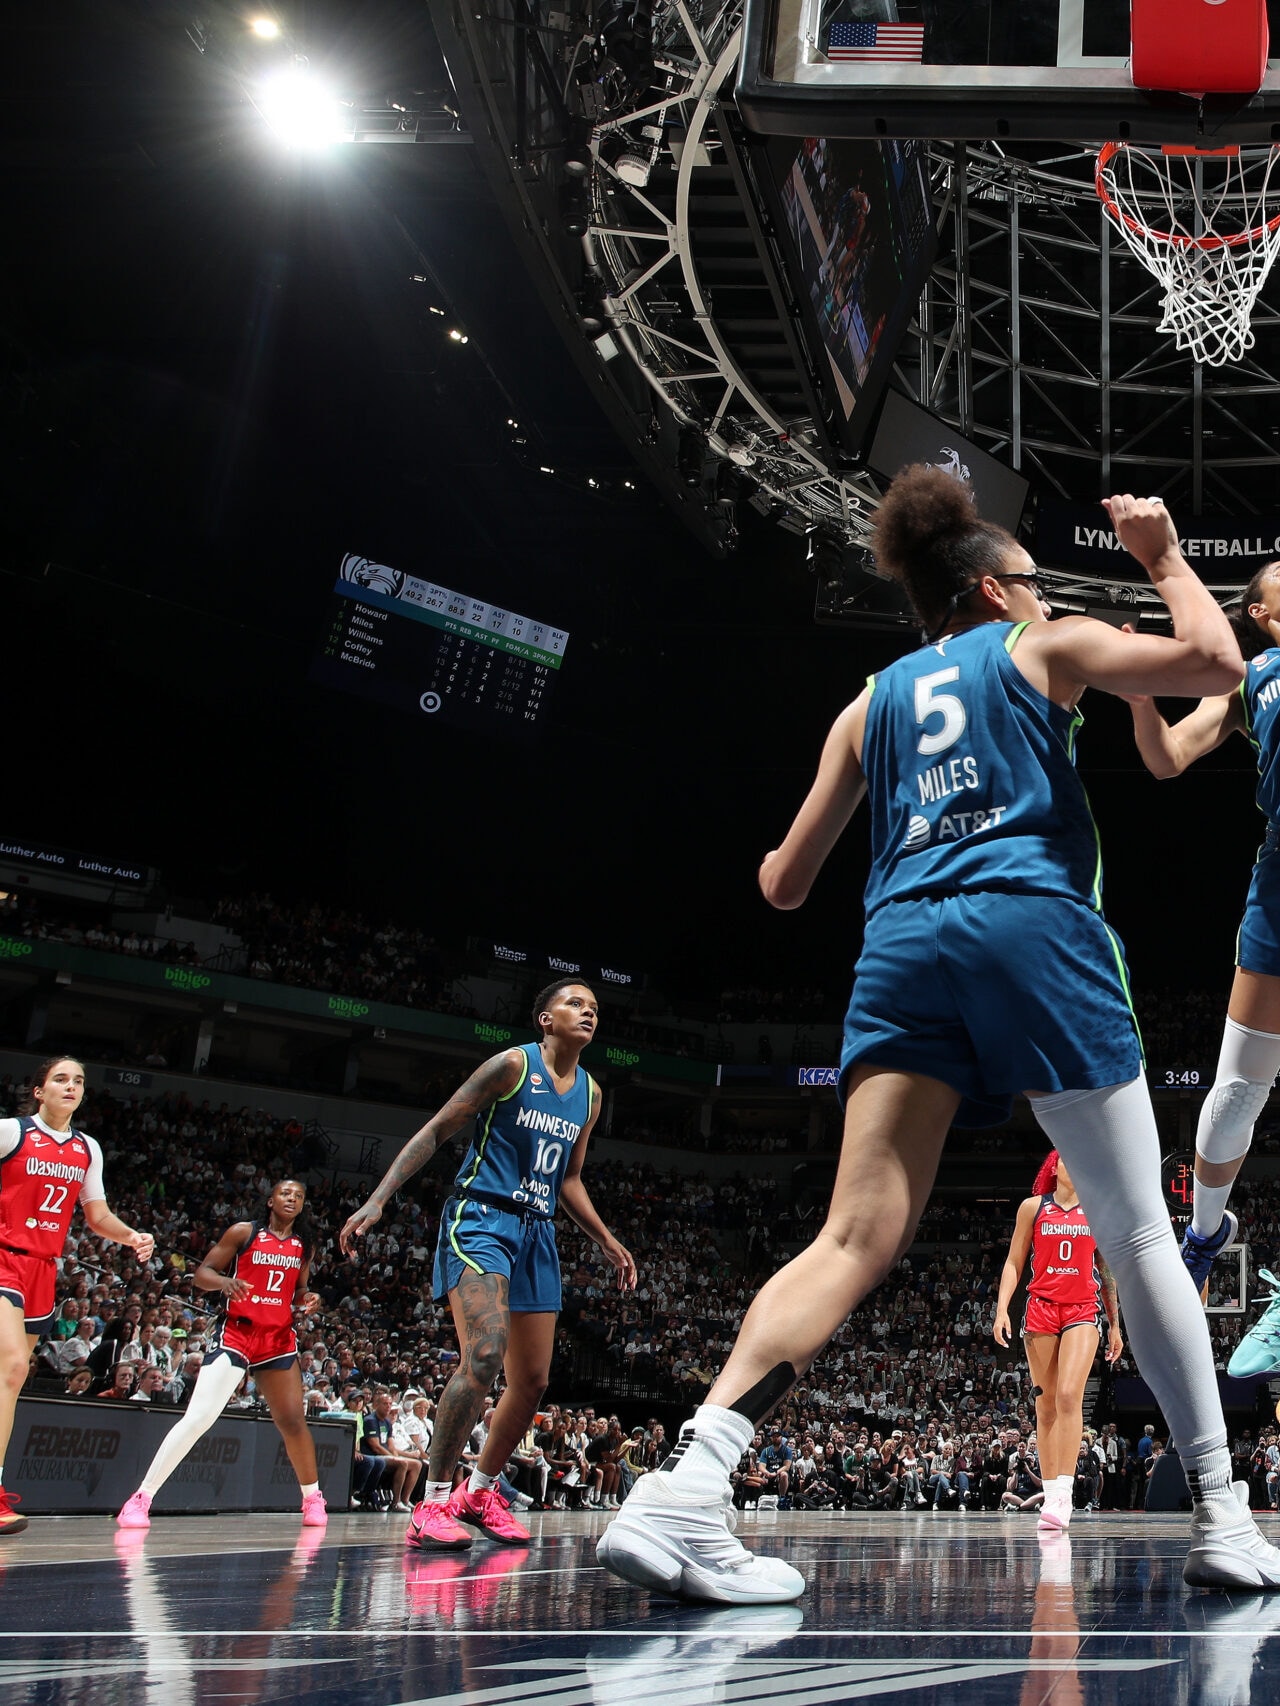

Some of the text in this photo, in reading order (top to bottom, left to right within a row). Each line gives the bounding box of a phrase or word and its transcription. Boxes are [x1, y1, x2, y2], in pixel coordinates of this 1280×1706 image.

[352, 616, 374, 629] Miles
[355, 603, 388, 621] Howard
[405, 590, 422, 601] 49.2
[426, 597, 443, 608] 26.7
[472, 613, 481, 622] 22
[492, 621, 501, 629] 17
[512, 628, 521, 636] 10
[445, 621, 457, 630] PTS
[474, 632, 488, 641] AST
[492, 611, 505, 619] AST
[514, 618, 523, 626] TO
[552, 632, 563, 640] BLK
[348, 627, 384, 646] Williams
[345, 640, 373, 656] Coffey
[341, 651, 376, 669] McBride
[914, 665, 966, 756] 5
[917, 756, 979, 806] MILES
[938, 806, 1007, 840] AT&T
[0, 842, 65, 865] Luther Auto
[79, 859, 141, 880] Luther Auto
[548, 956, 581, 973] Wings
[165, 968, 211, 989] bibigo
[600, 968, 632, 984] Wings
[329, 997, 369, 1016] bibigo
[475, 1024, 511, 1042] bibigo
[607, 1048, 640, 1066] bibigo
[117, 1070, 141, 1085] 136
[1165, 1071, 1200, 1085] 3:49
[532, 1137, 563, 1175] 10
[520, 1176, 550, 1198] MAYO
[38, 1183, 68, 1214] 22
[1041, 1221, 1091, 1239] Washington
[1059, 1239, 1072, 1261] 0
[266, 1270, 285, 1292] 12
[23, 1425, 121, 1460] FEDERATED
[16, 1458, 89, 1481] INSURANCE
